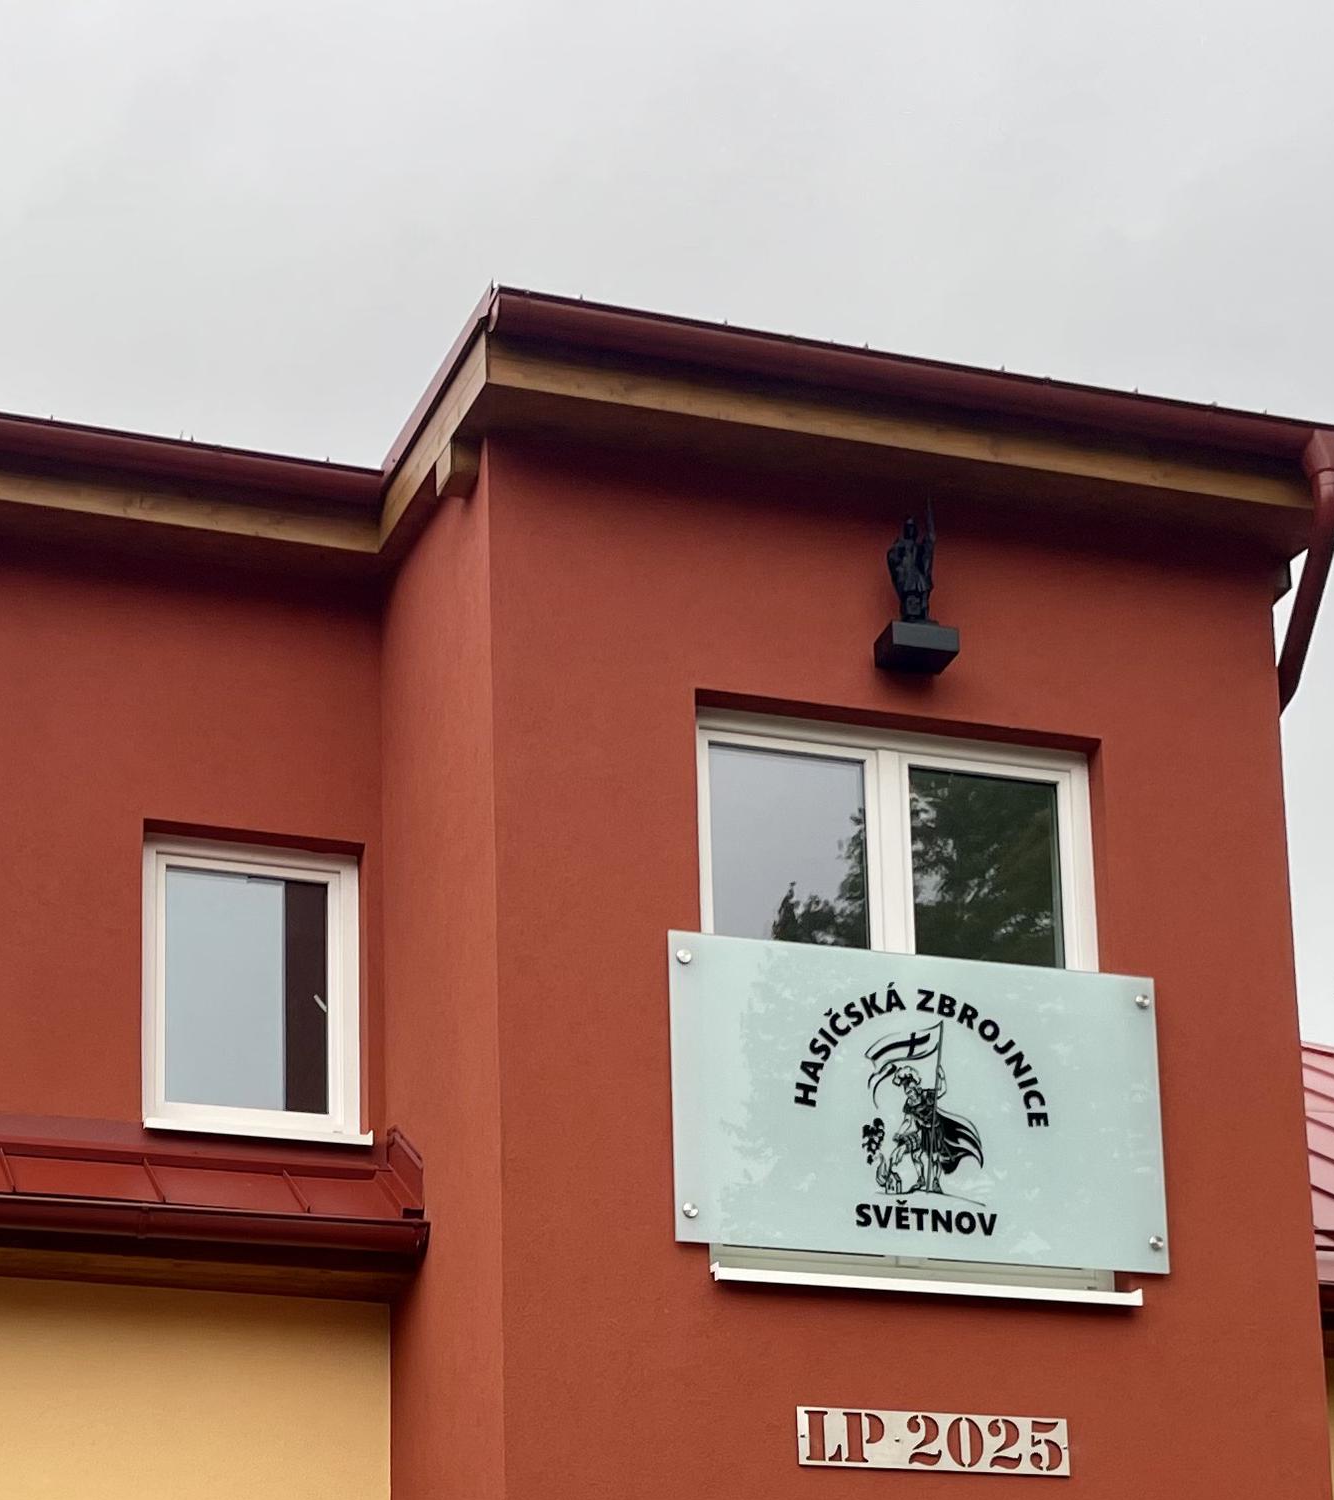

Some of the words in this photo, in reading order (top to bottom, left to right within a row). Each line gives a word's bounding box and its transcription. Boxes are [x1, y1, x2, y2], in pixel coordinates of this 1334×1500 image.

[794, 982, 906, 1107] HASIČSKÁ
[916, 988, 1049, 1128] ZBROJNICE
[855, 1200, 997, 1236] SVĚTNOV
[804, 1410, 884, 1463] LP
[907, 1414, 1062, 1471] 2025
